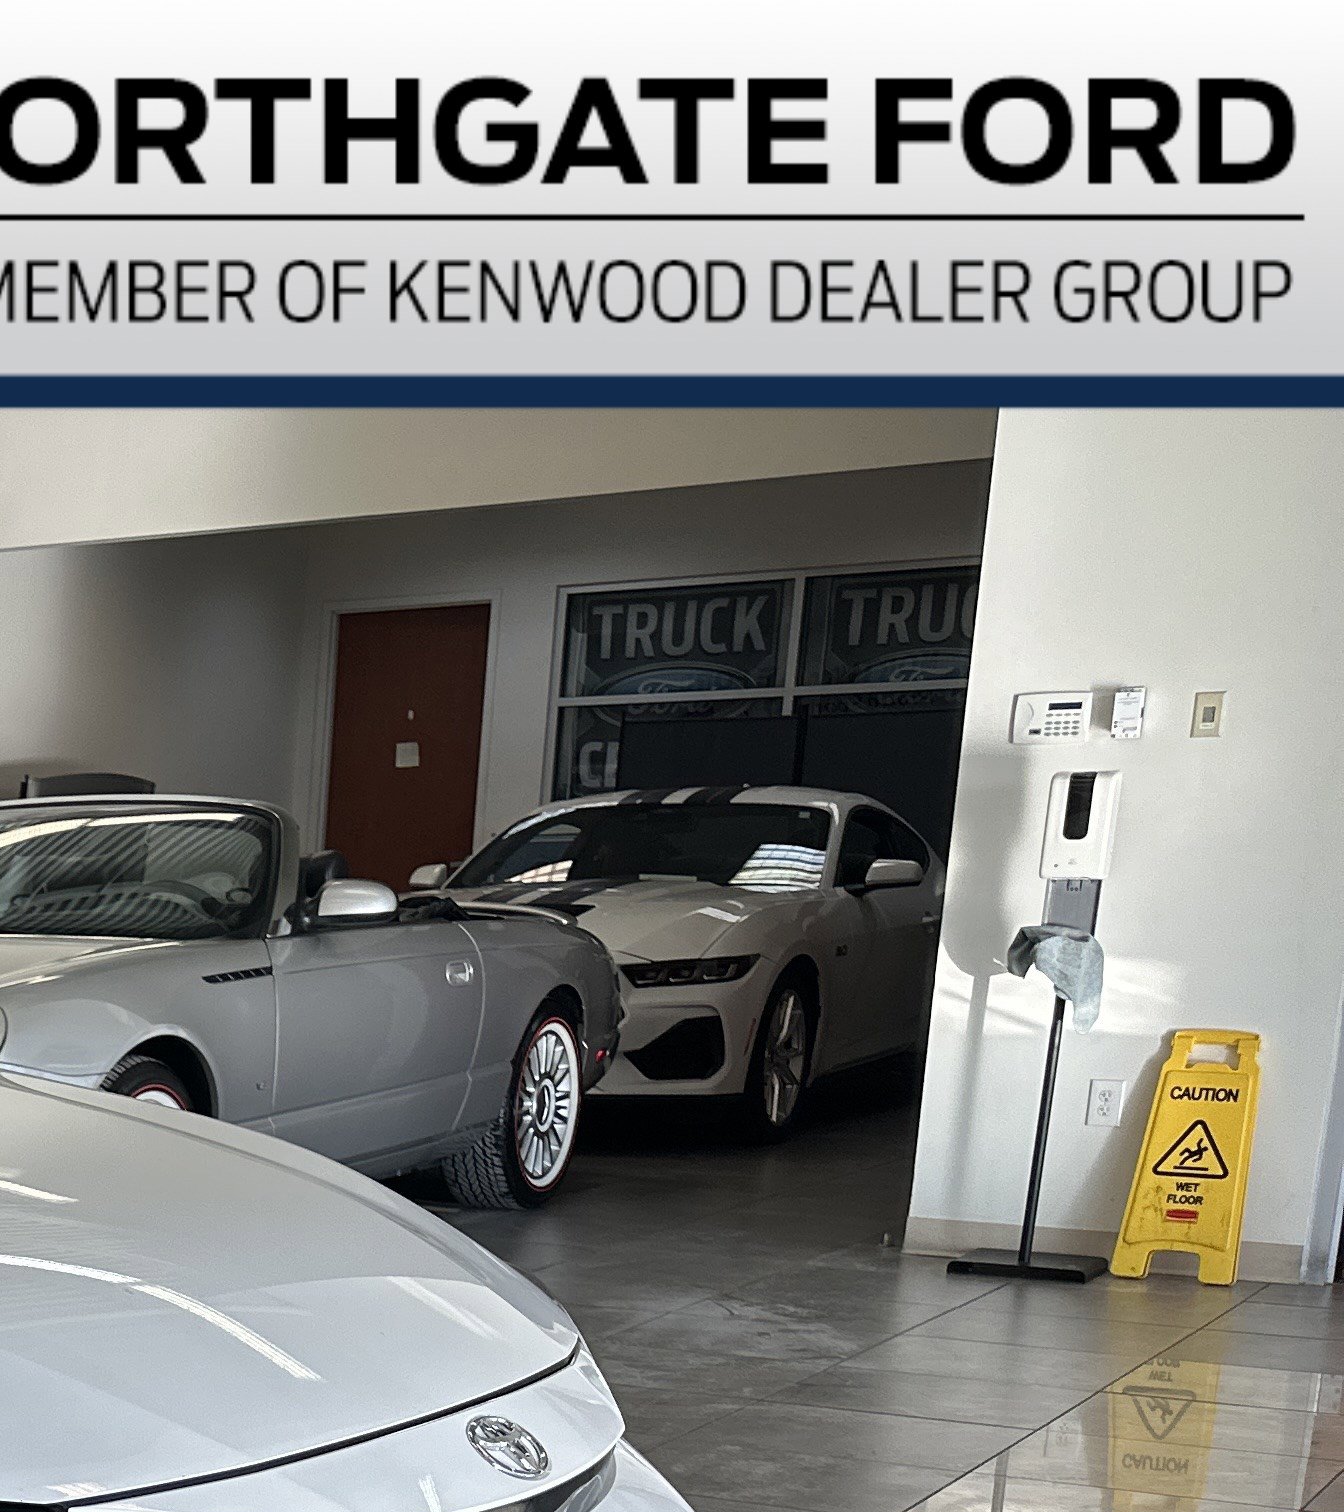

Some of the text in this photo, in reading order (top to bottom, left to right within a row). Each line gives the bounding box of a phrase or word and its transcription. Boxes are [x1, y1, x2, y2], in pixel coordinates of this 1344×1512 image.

[592, 595, 768, 660] TRUCK
[1169, 1085, 1240, 1103] CAUTION
[1175, 1181, 1200, 1193] WET
[1166, 1194, 1204, 1206] FLOOR
